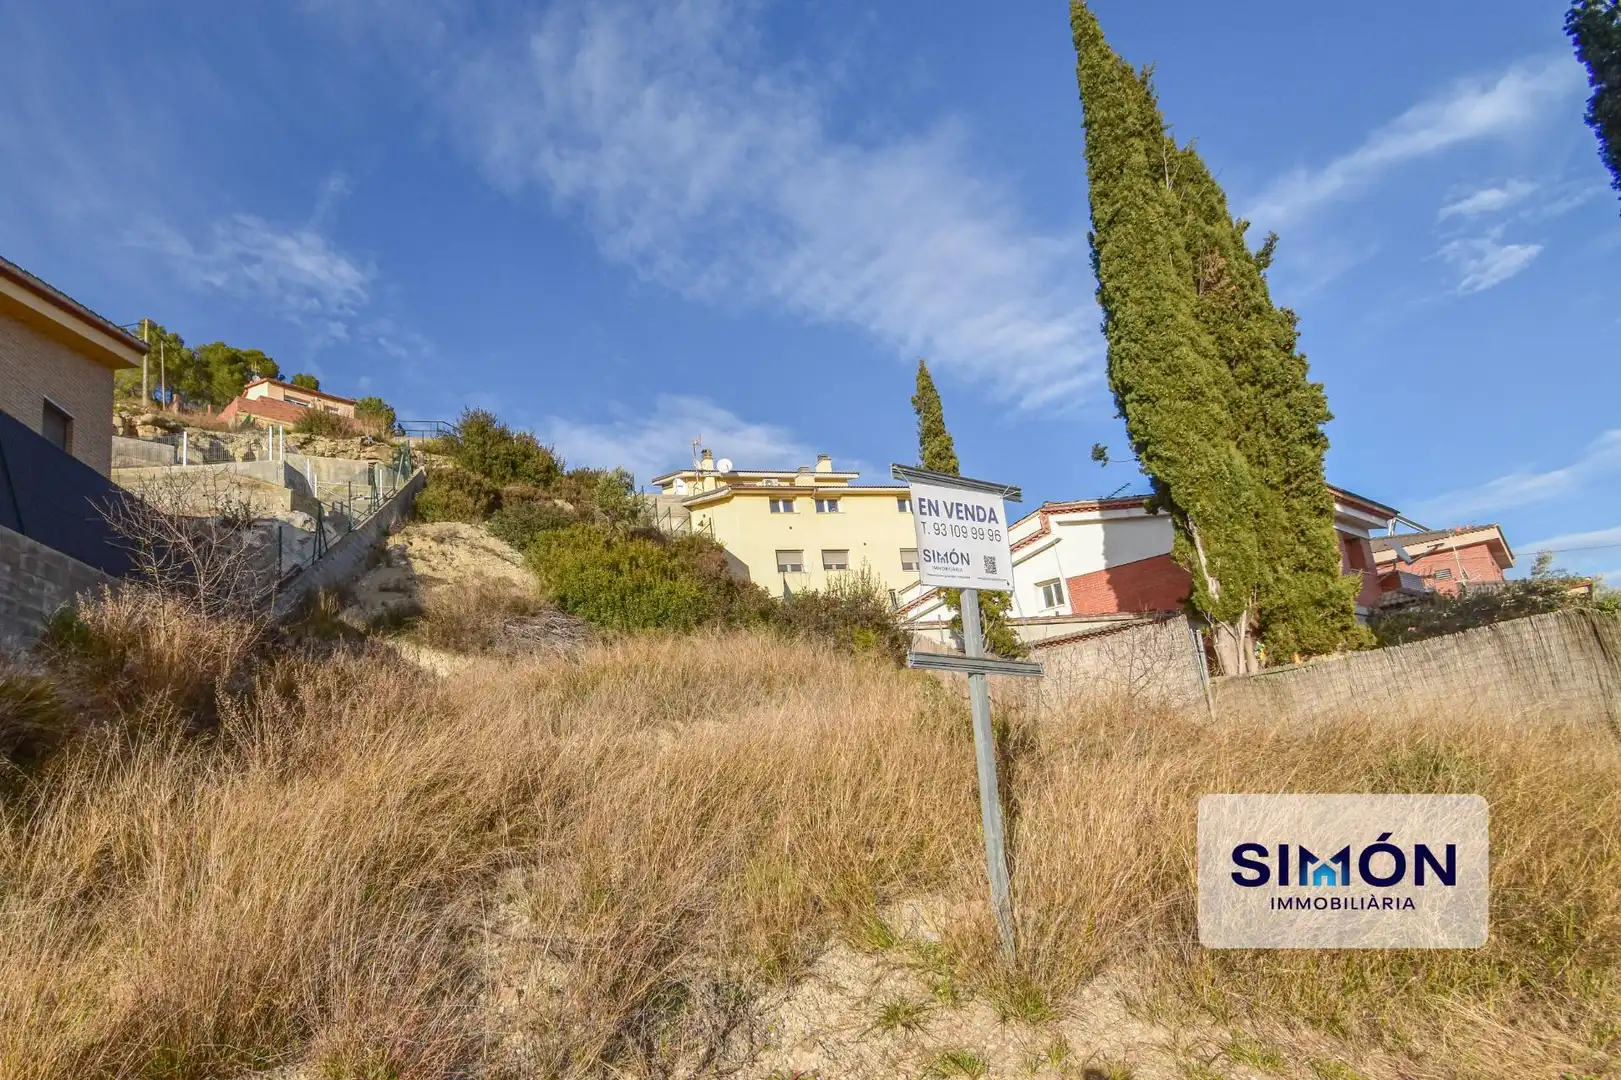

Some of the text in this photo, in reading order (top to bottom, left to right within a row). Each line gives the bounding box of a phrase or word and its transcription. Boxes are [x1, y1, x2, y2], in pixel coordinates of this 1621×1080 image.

[918, 497, 999, 524] EN VENDA
[921, 521, 1002, 543] T. 93 109 99 96
[923, 548, 970, 566] SIMÓN
